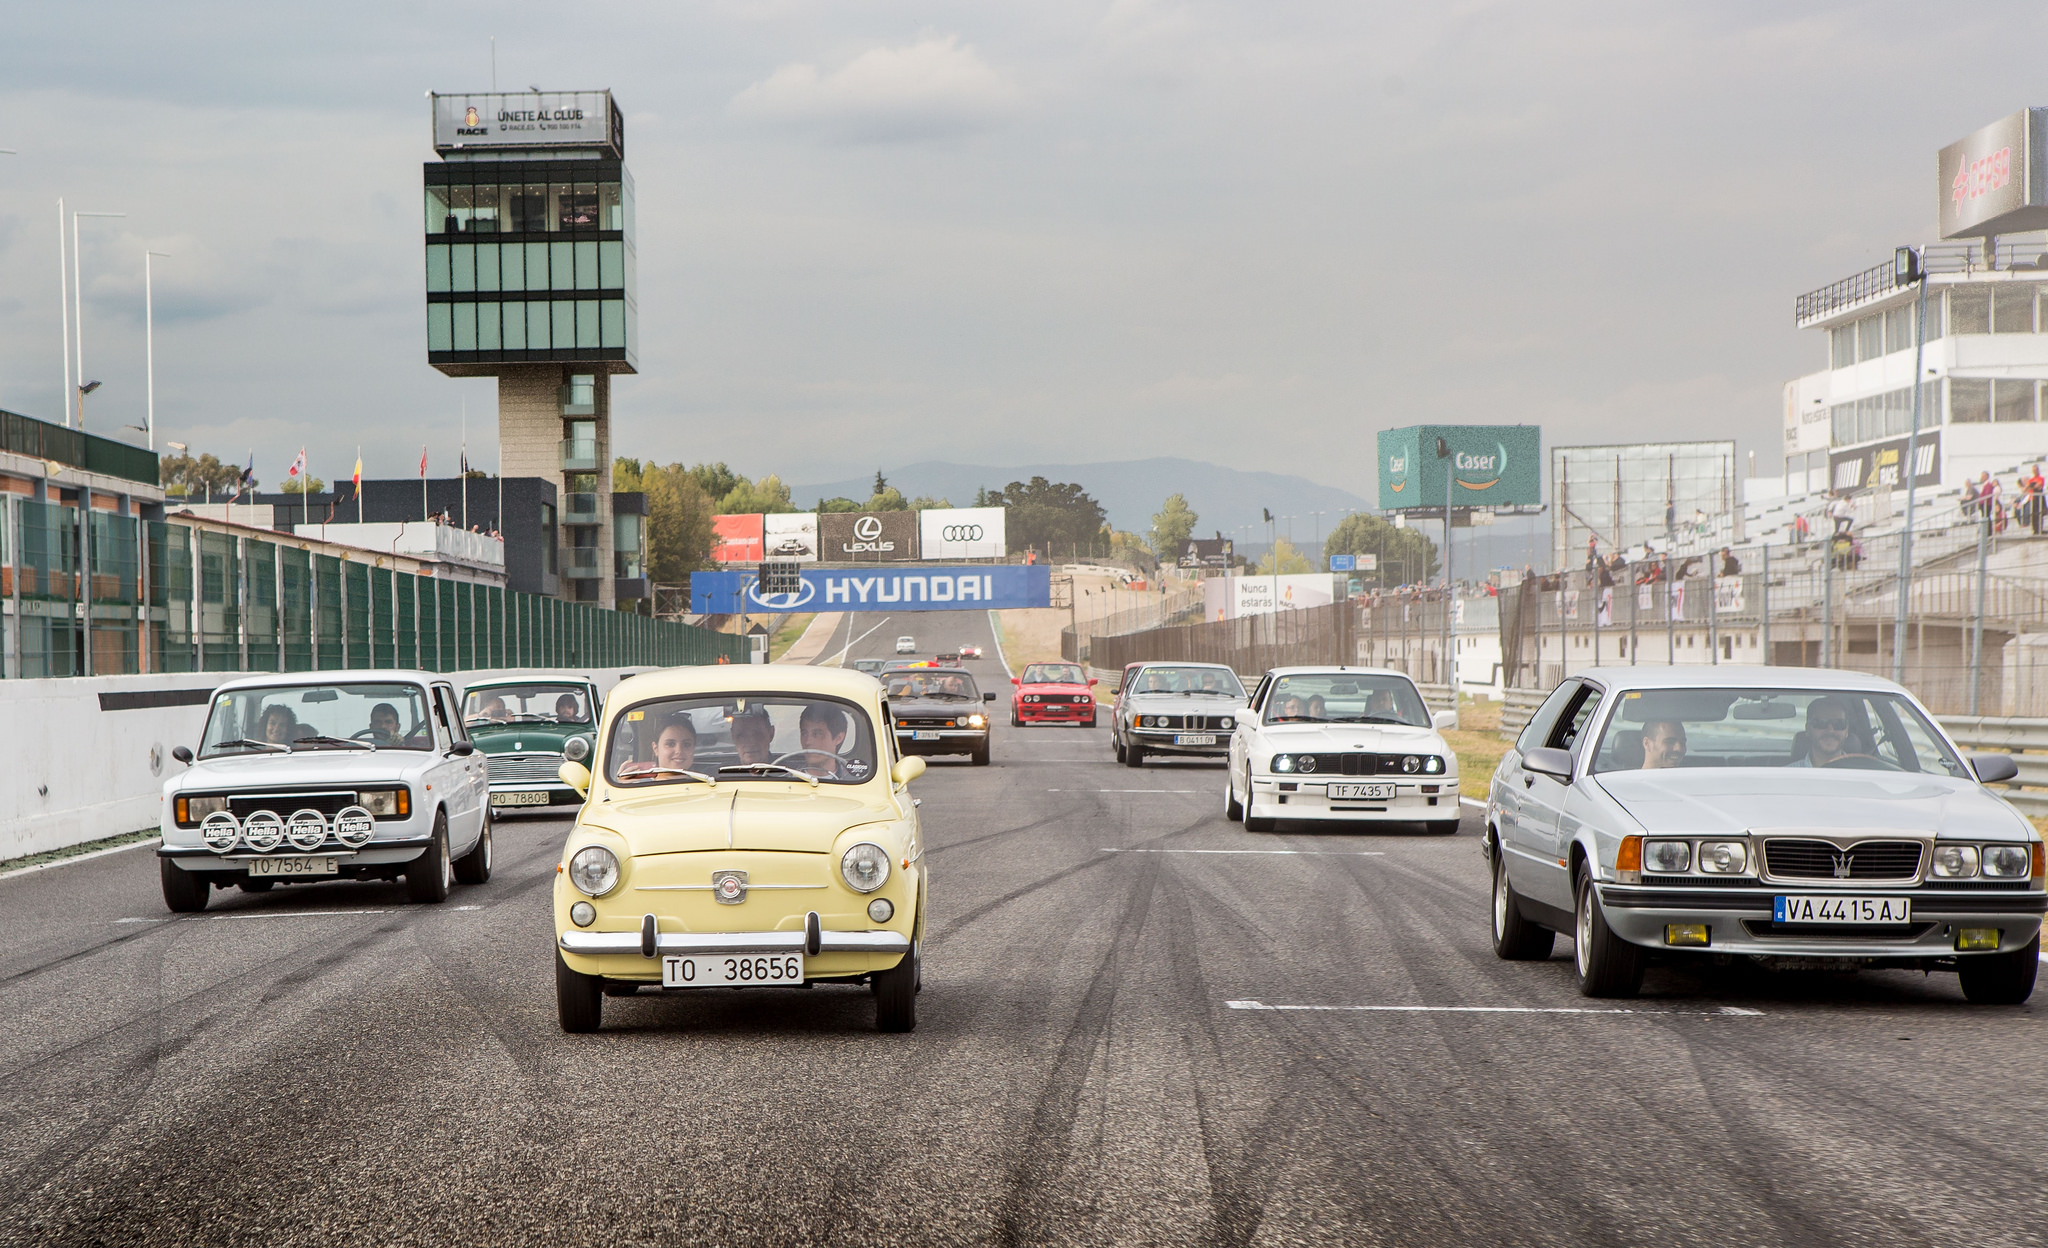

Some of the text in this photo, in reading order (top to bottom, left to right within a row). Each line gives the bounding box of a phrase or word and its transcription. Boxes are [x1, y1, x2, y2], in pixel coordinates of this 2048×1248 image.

[497, 108, 583, 122] ÚNETE AL CLUB
[457, 128, 488, 136] RACE
[1969, 146, 2011, 201] CEPSA
[1455, 452, 1496, 470] Caser
[843, 541, 895, 553] LEXUS
[826, 575, 993, 603] HYUNDAI
[1241, 583, 1268, 594] Nunca
[1335, 785, 1392, 796] TF 7435 Y
[492, 794, 506, 804] PO
[206, 827, 234, 838] Hella
[248, 826, 278, 836] Hella
[292, 825, 321, 835] Hella
[341, 822, 370, 832] Hella
[326, 857, 336, 872] E
[666, 959, 696, 982] TO
[724, 957, 799, 981] 38656
